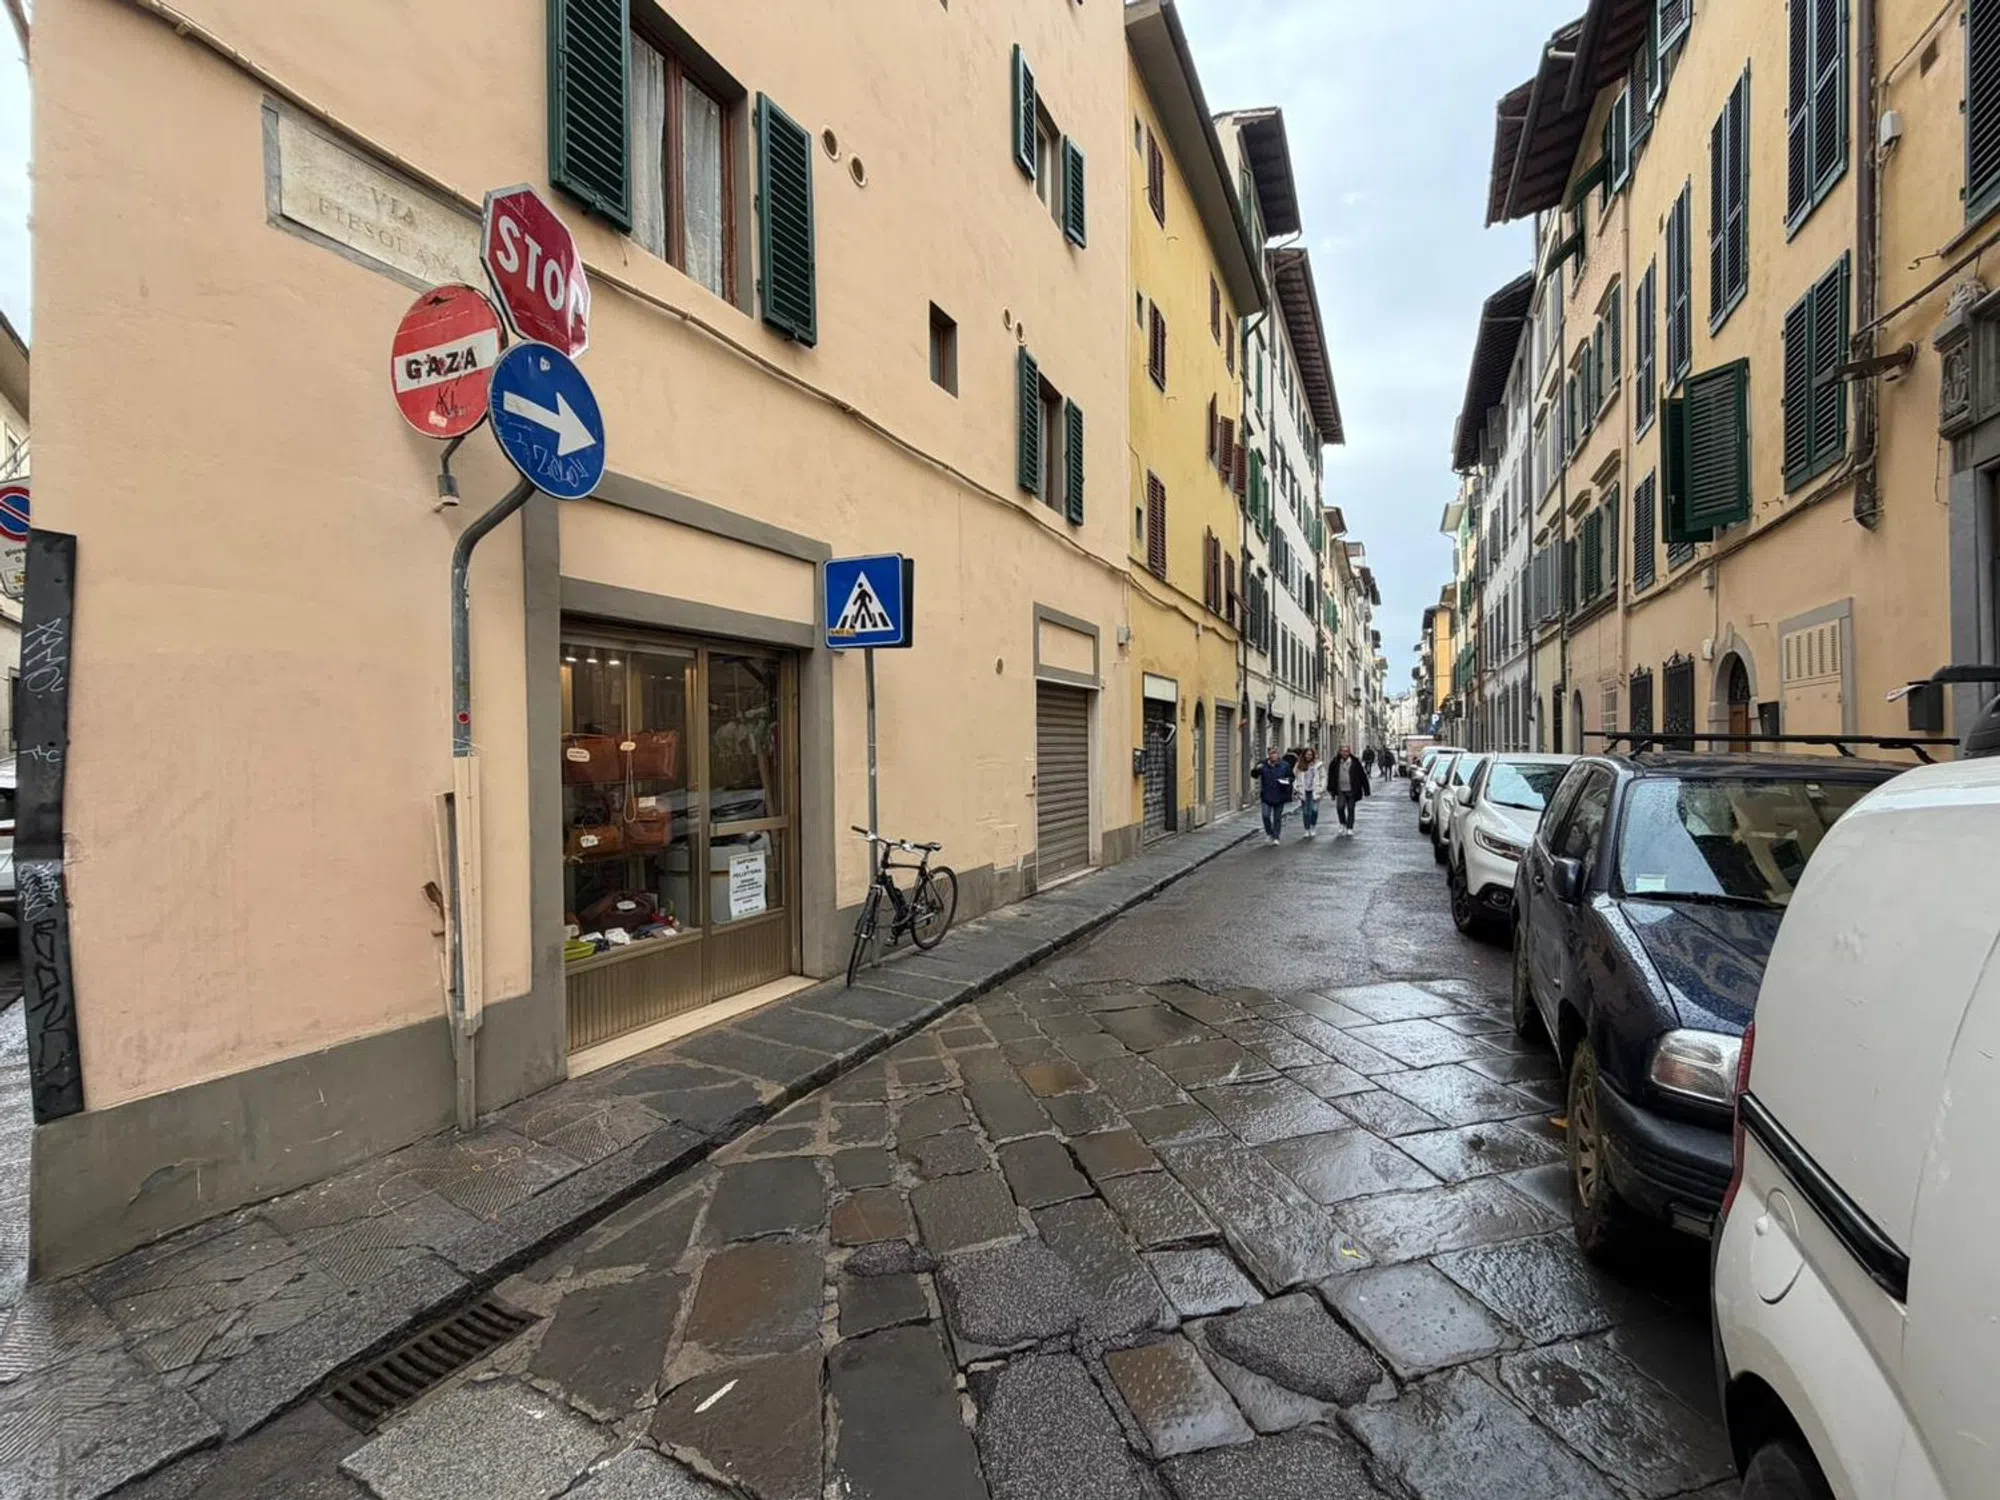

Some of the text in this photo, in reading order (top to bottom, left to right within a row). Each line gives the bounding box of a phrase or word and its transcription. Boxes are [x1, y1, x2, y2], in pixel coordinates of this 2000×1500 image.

[369, 186, 418, 226] VIA
[406, 345, 478, 380] GAZA
[1431, 713, 1440, 726] P
